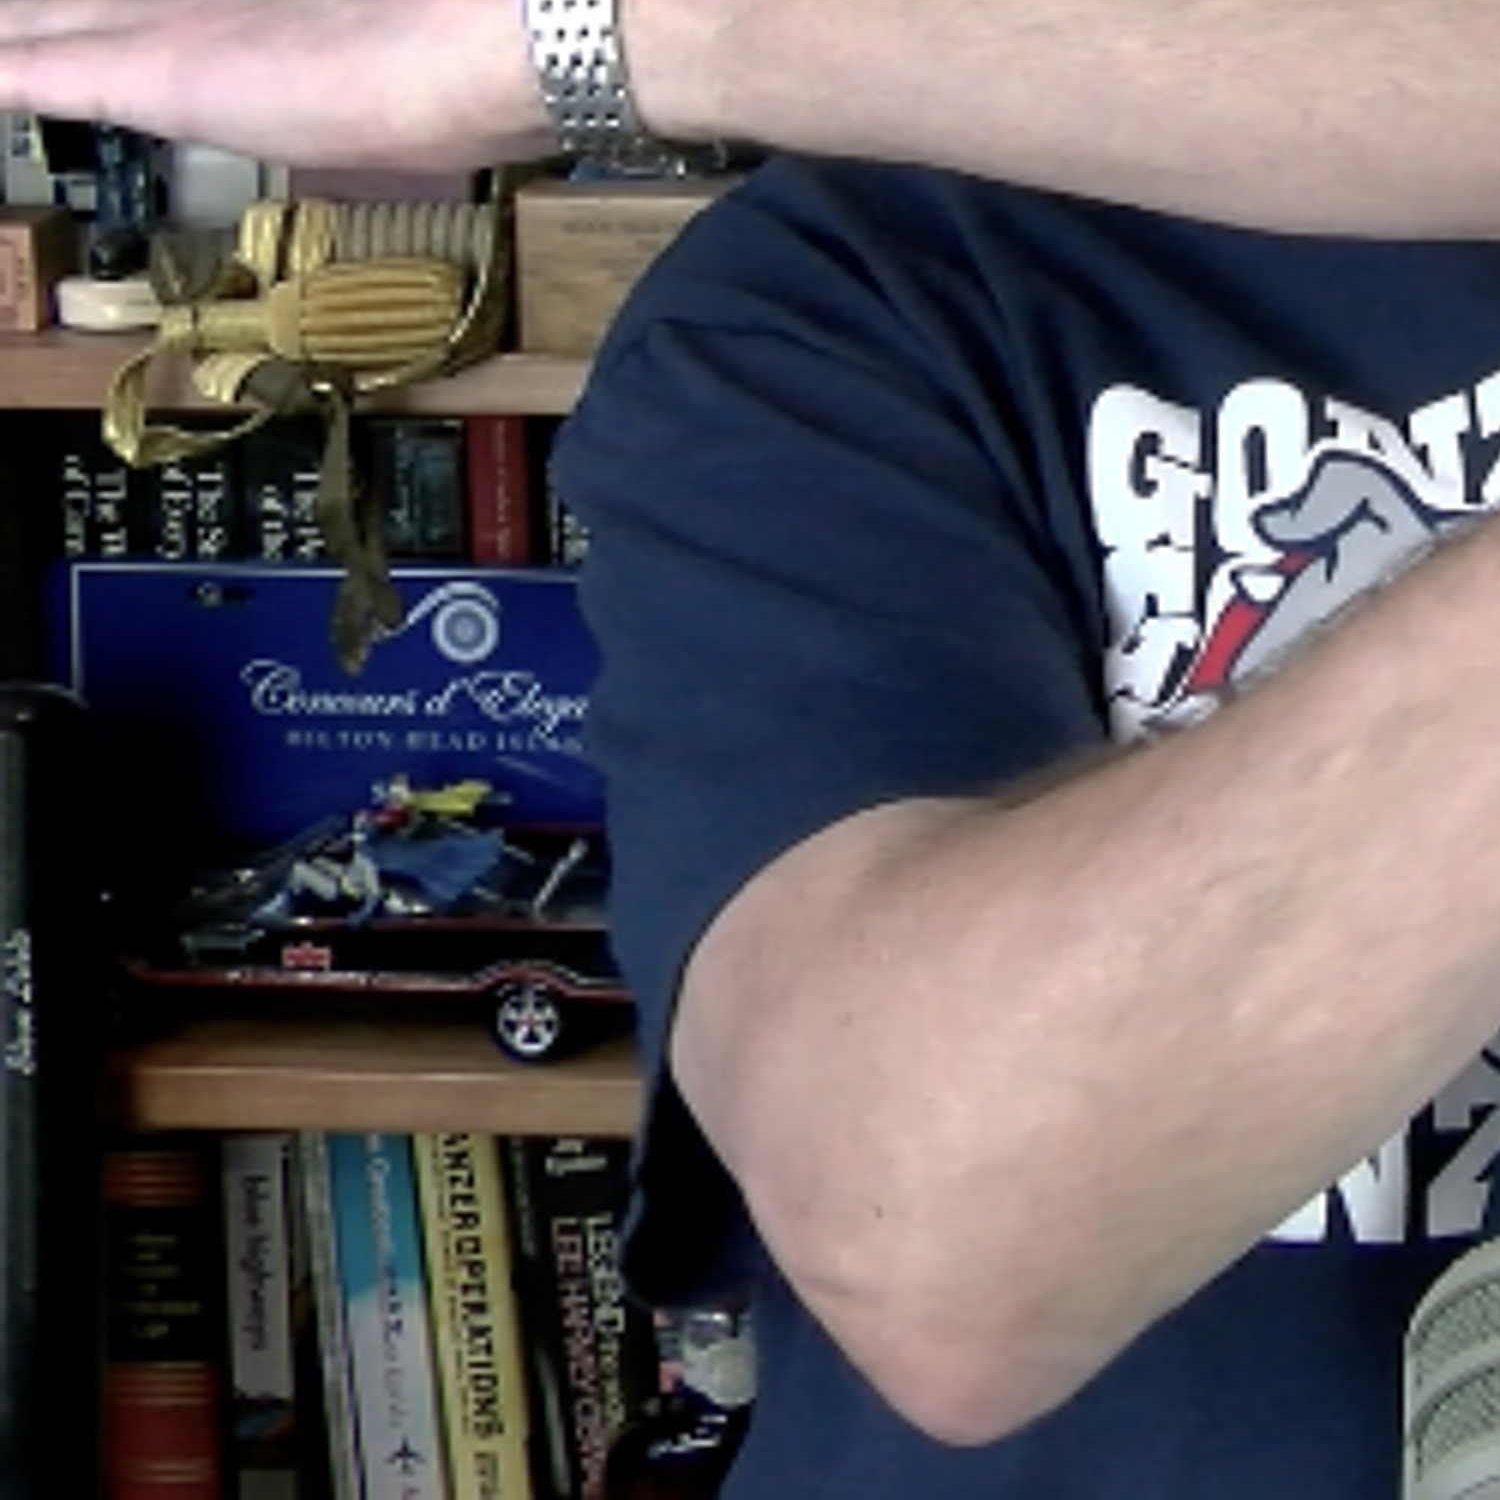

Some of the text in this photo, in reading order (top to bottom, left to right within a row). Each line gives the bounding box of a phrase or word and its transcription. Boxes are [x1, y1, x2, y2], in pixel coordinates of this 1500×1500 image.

[284, 730, 394, 750] HILTON
[406, 731, 486, 752] HEAD
[585, 1214, 626, 1334] LEGEND
